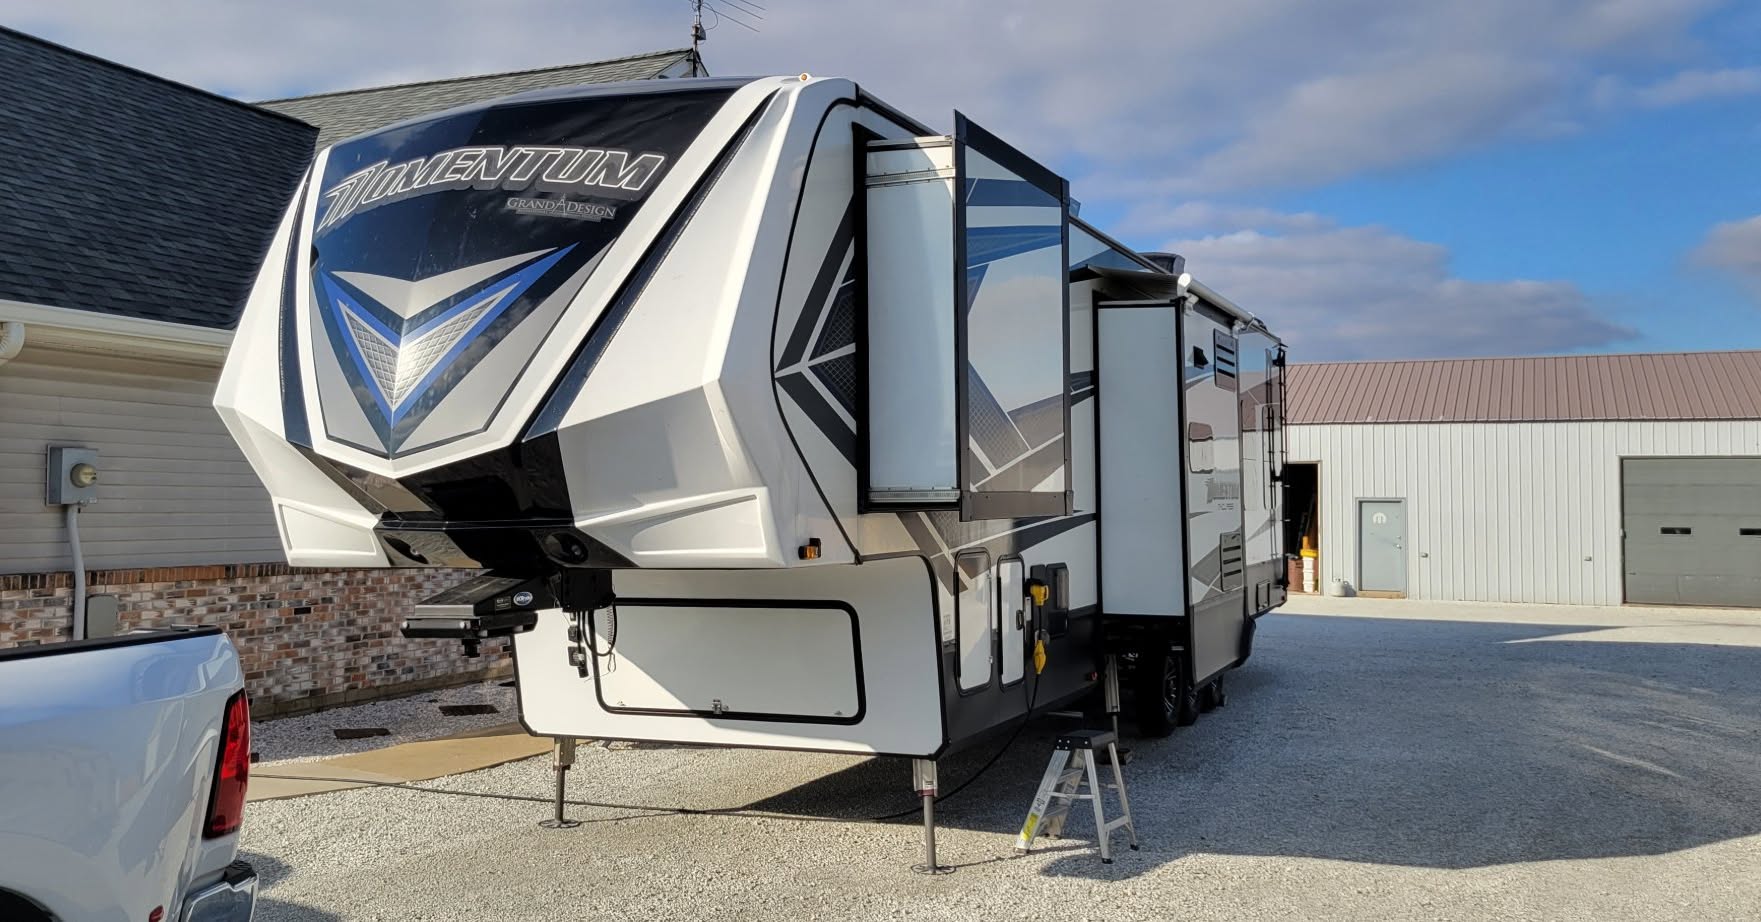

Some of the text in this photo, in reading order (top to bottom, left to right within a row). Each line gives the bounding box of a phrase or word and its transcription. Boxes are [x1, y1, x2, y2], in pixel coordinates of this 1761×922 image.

[316, 147, 664, 232] MOMENTUM
[507, 197, 555, 210] GRAND
[566, 201, 616, 217] DESIGN
